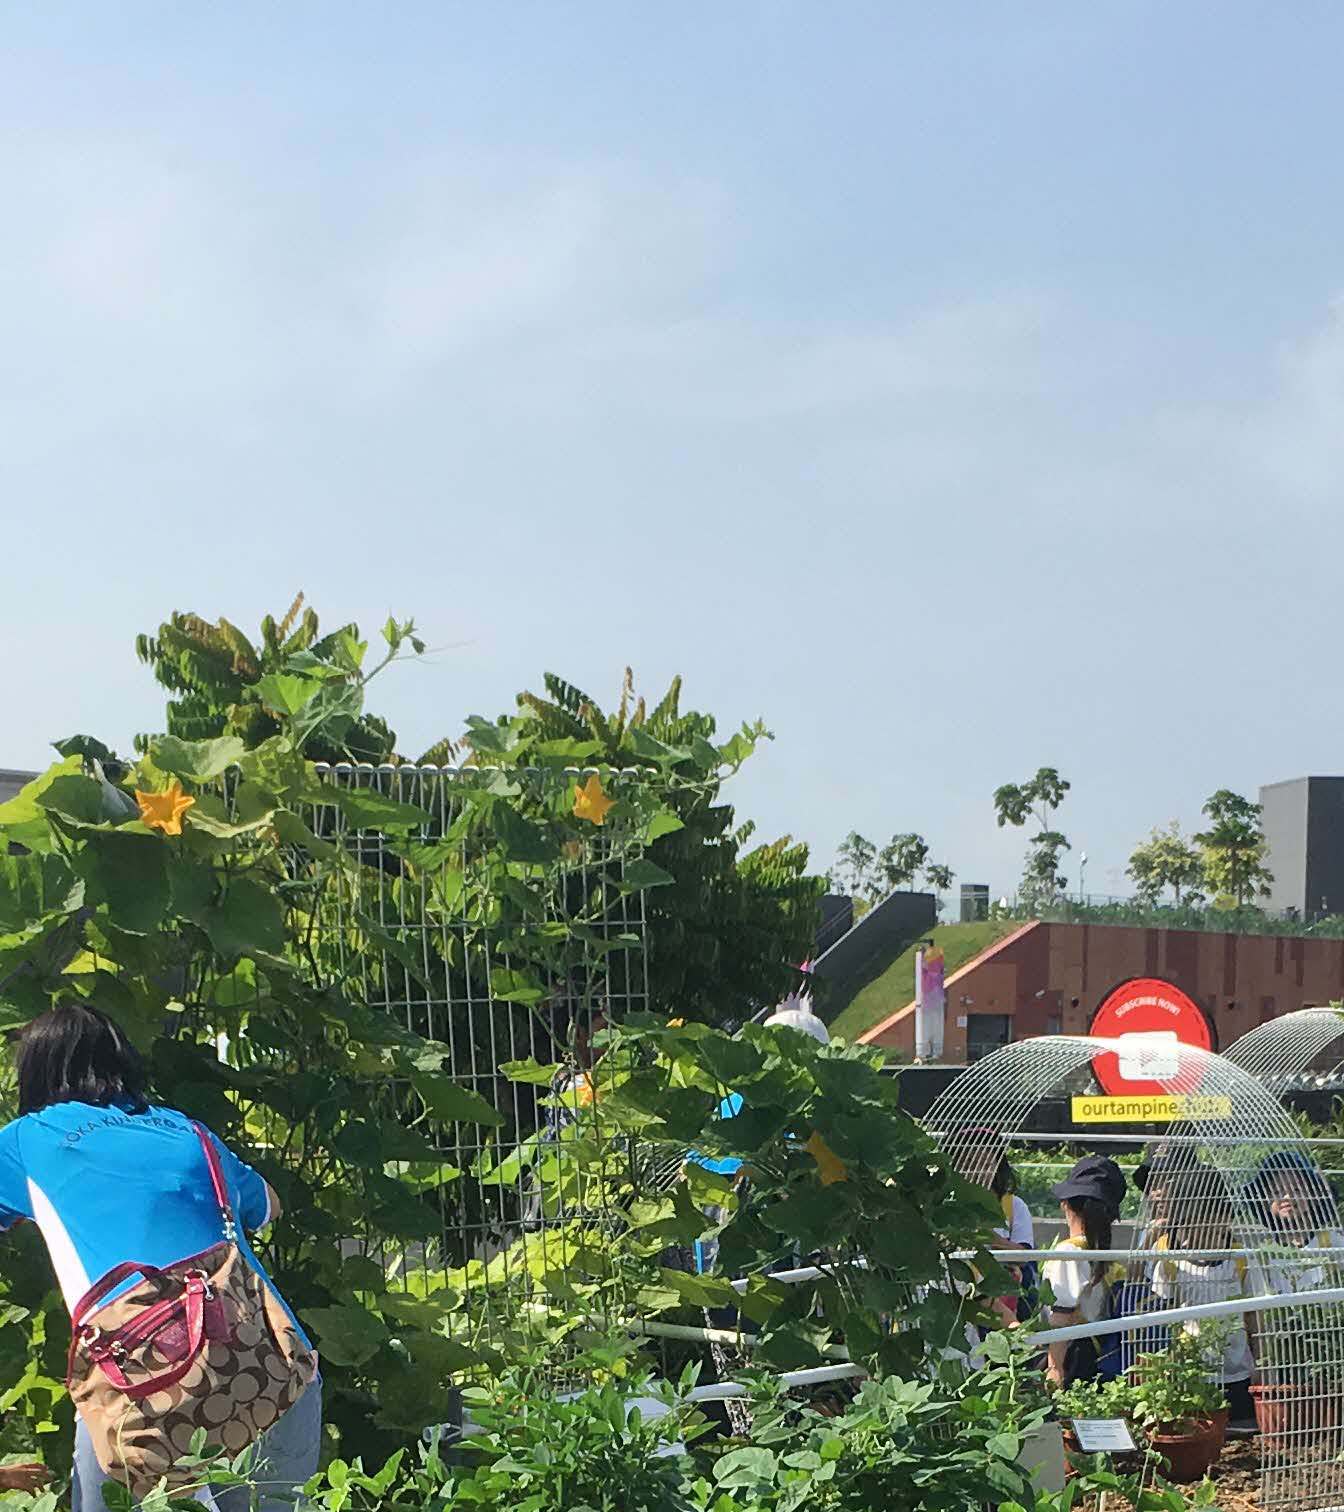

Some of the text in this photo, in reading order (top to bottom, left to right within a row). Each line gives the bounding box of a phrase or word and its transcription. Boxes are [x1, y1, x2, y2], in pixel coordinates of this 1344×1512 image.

[1114, 996, 1181, 1018] SUBSCRIBE NOW!
[1082, 1098, 1219, 1118] ourtampine
